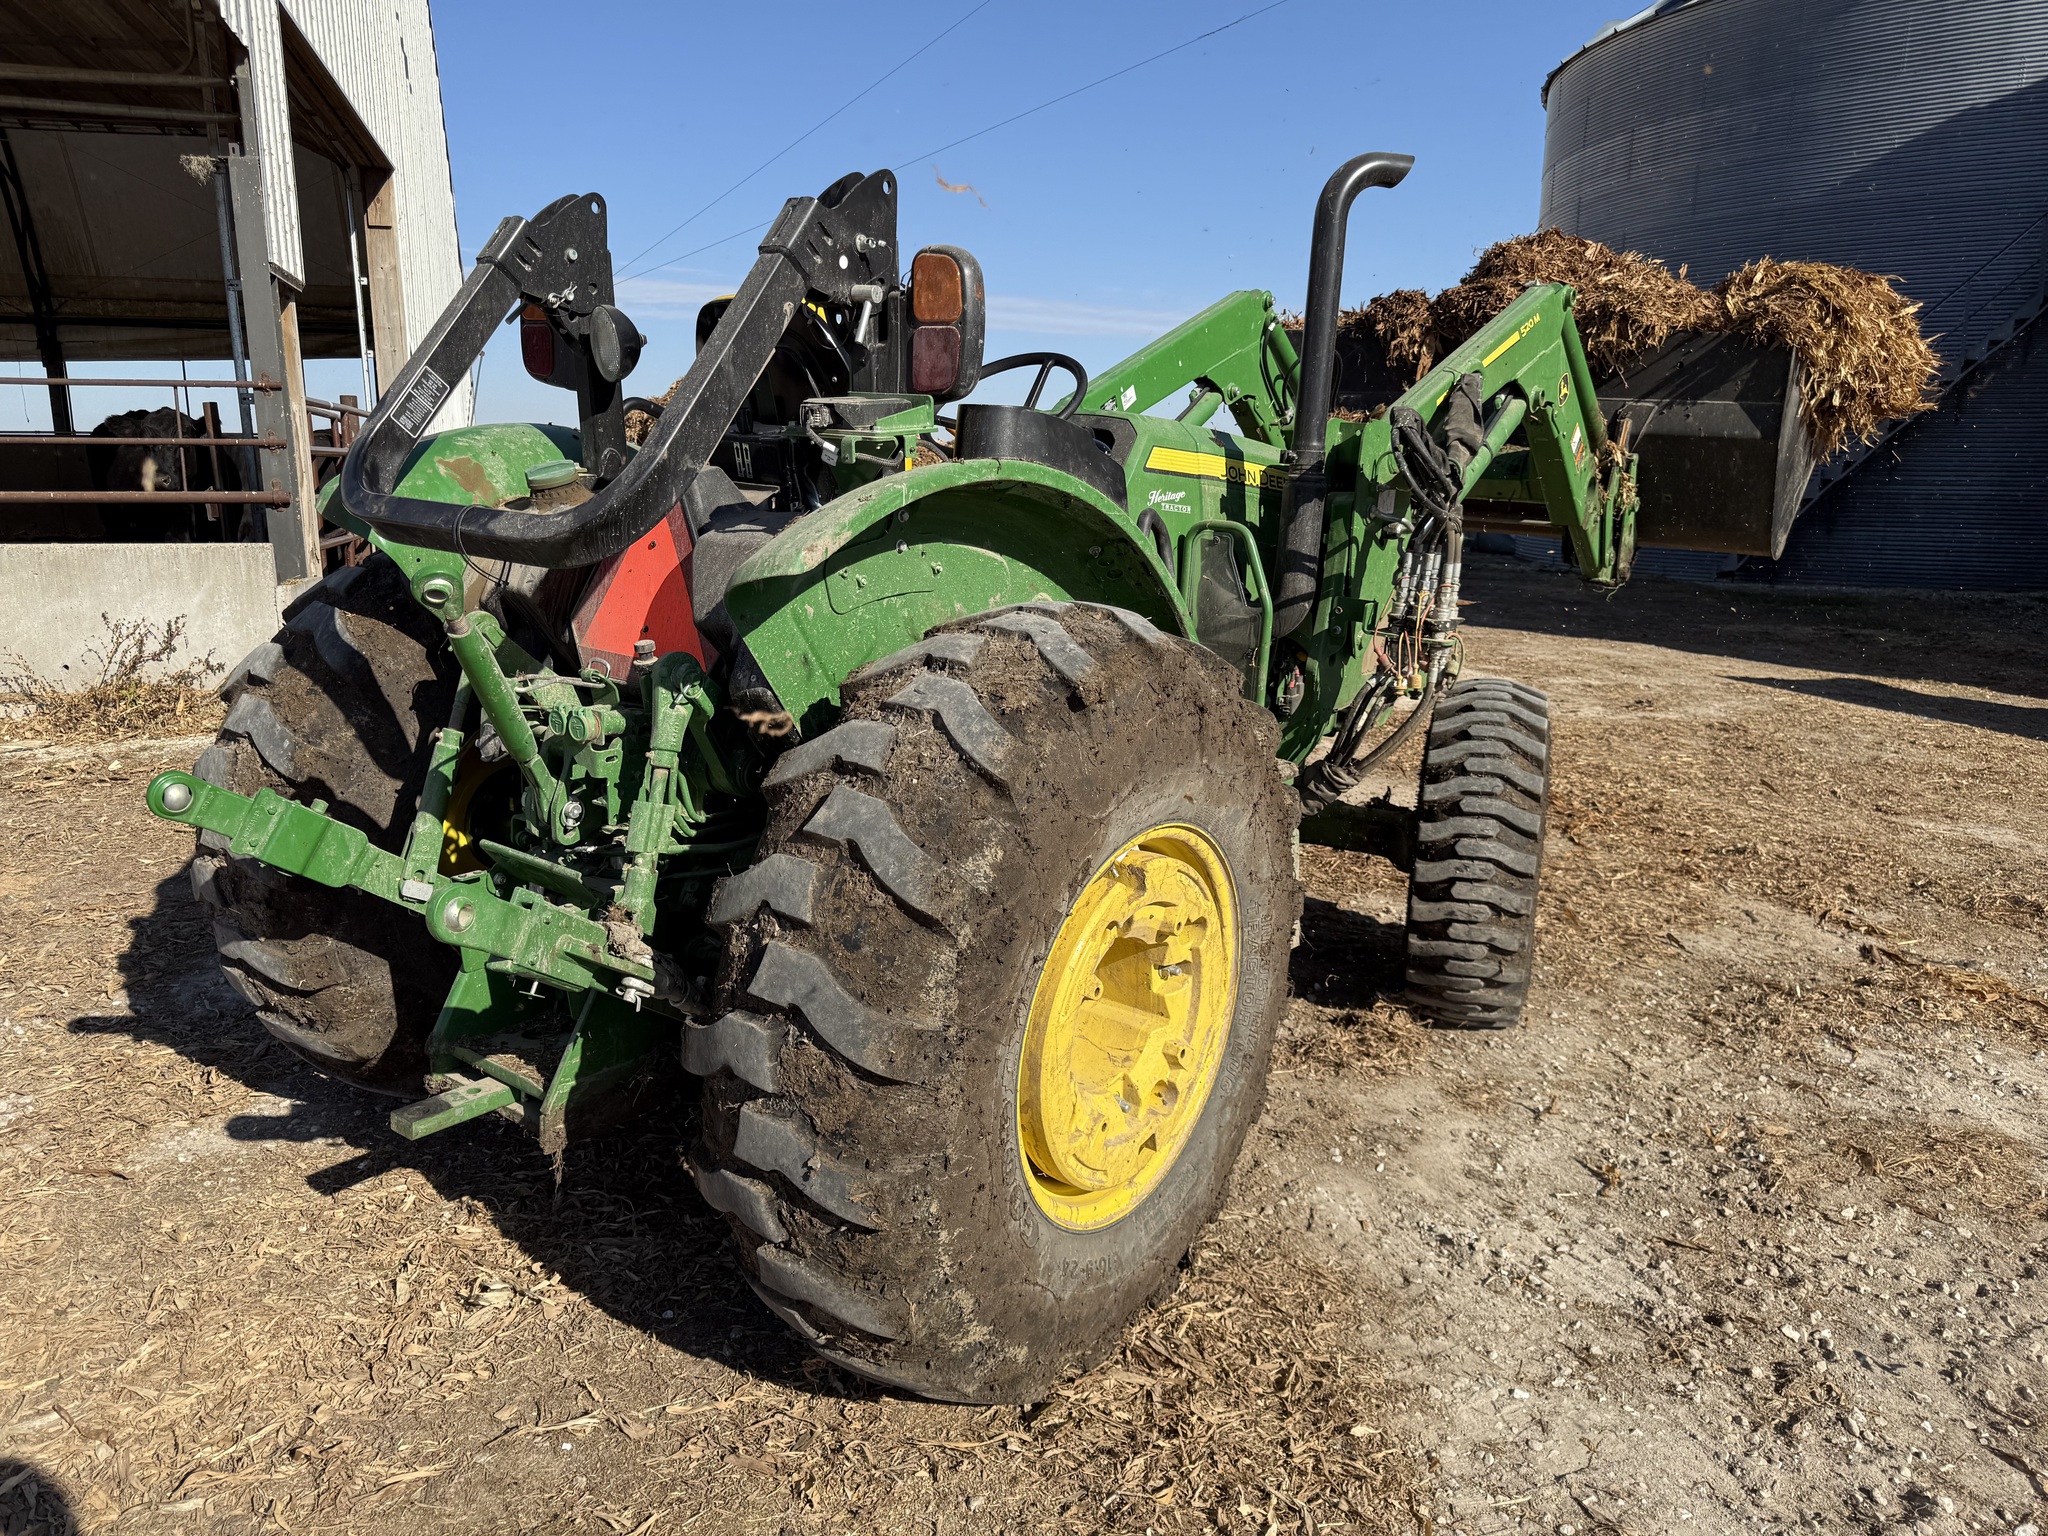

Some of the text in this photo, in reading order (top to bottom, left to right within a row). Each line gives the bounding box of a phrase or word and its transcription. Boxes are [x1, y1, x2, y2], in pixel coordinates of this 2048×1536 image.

[1221, 463, 1287, 489] JOHN DEE
[1147, 489, 1186, 506] Heritage
[1161, 503, 1191, 514] TRACTOR
[1219, 901, 1261, 1095] TRACTOR LUG
